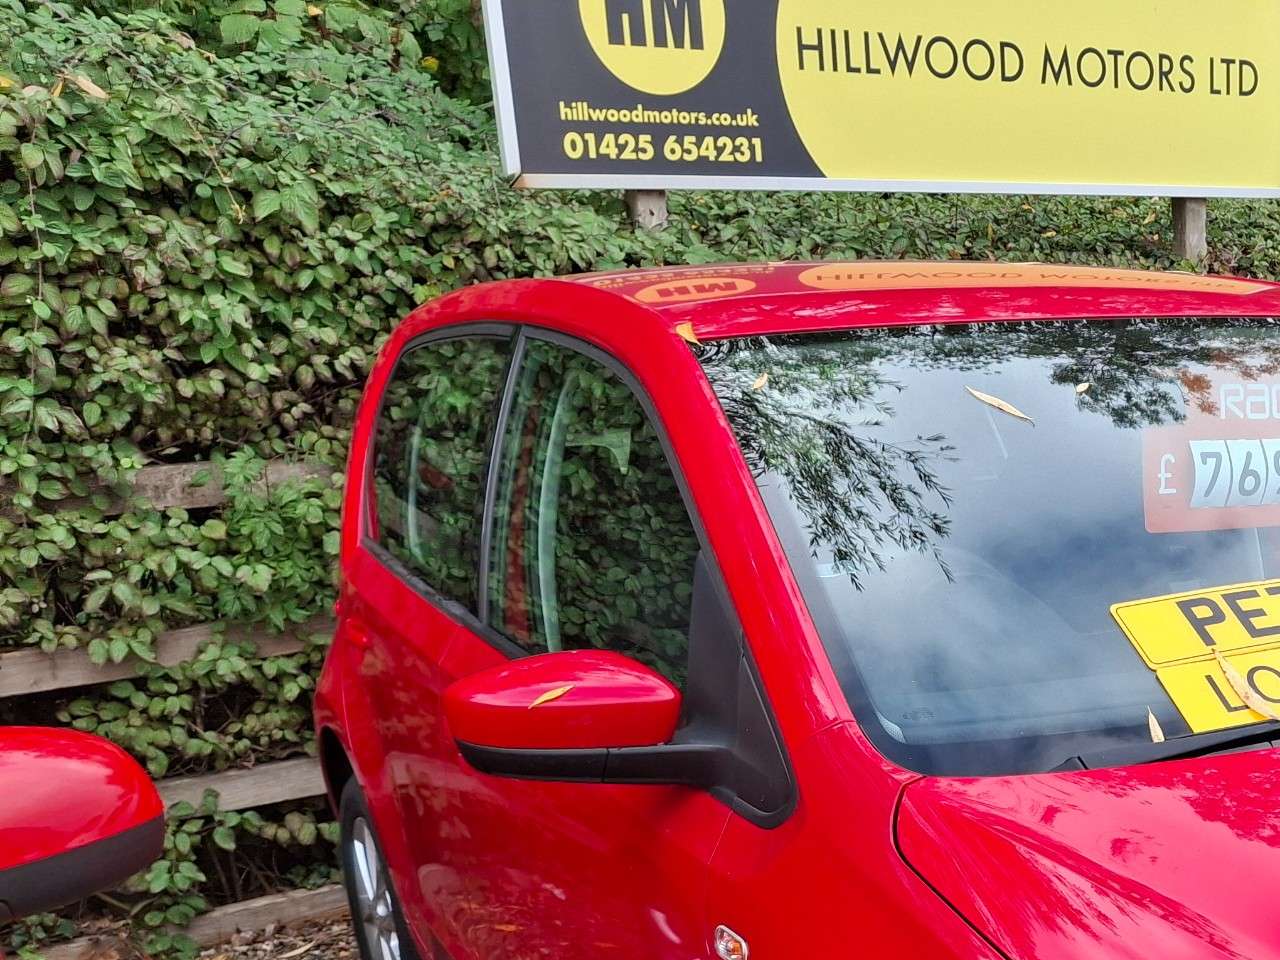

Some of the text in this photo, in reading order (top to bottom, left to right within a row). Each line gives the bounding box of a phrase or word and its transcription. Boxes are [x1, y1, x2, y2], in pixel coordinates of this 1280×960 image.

[604, 0, 704, 50] HM
[795, 26, 1259, 97] HILLWOOD MOTORS LTD
[559, 100, 760, 127] hillwoodmotors.co.uk
[563, 131, 764, 163] 01425 654231
